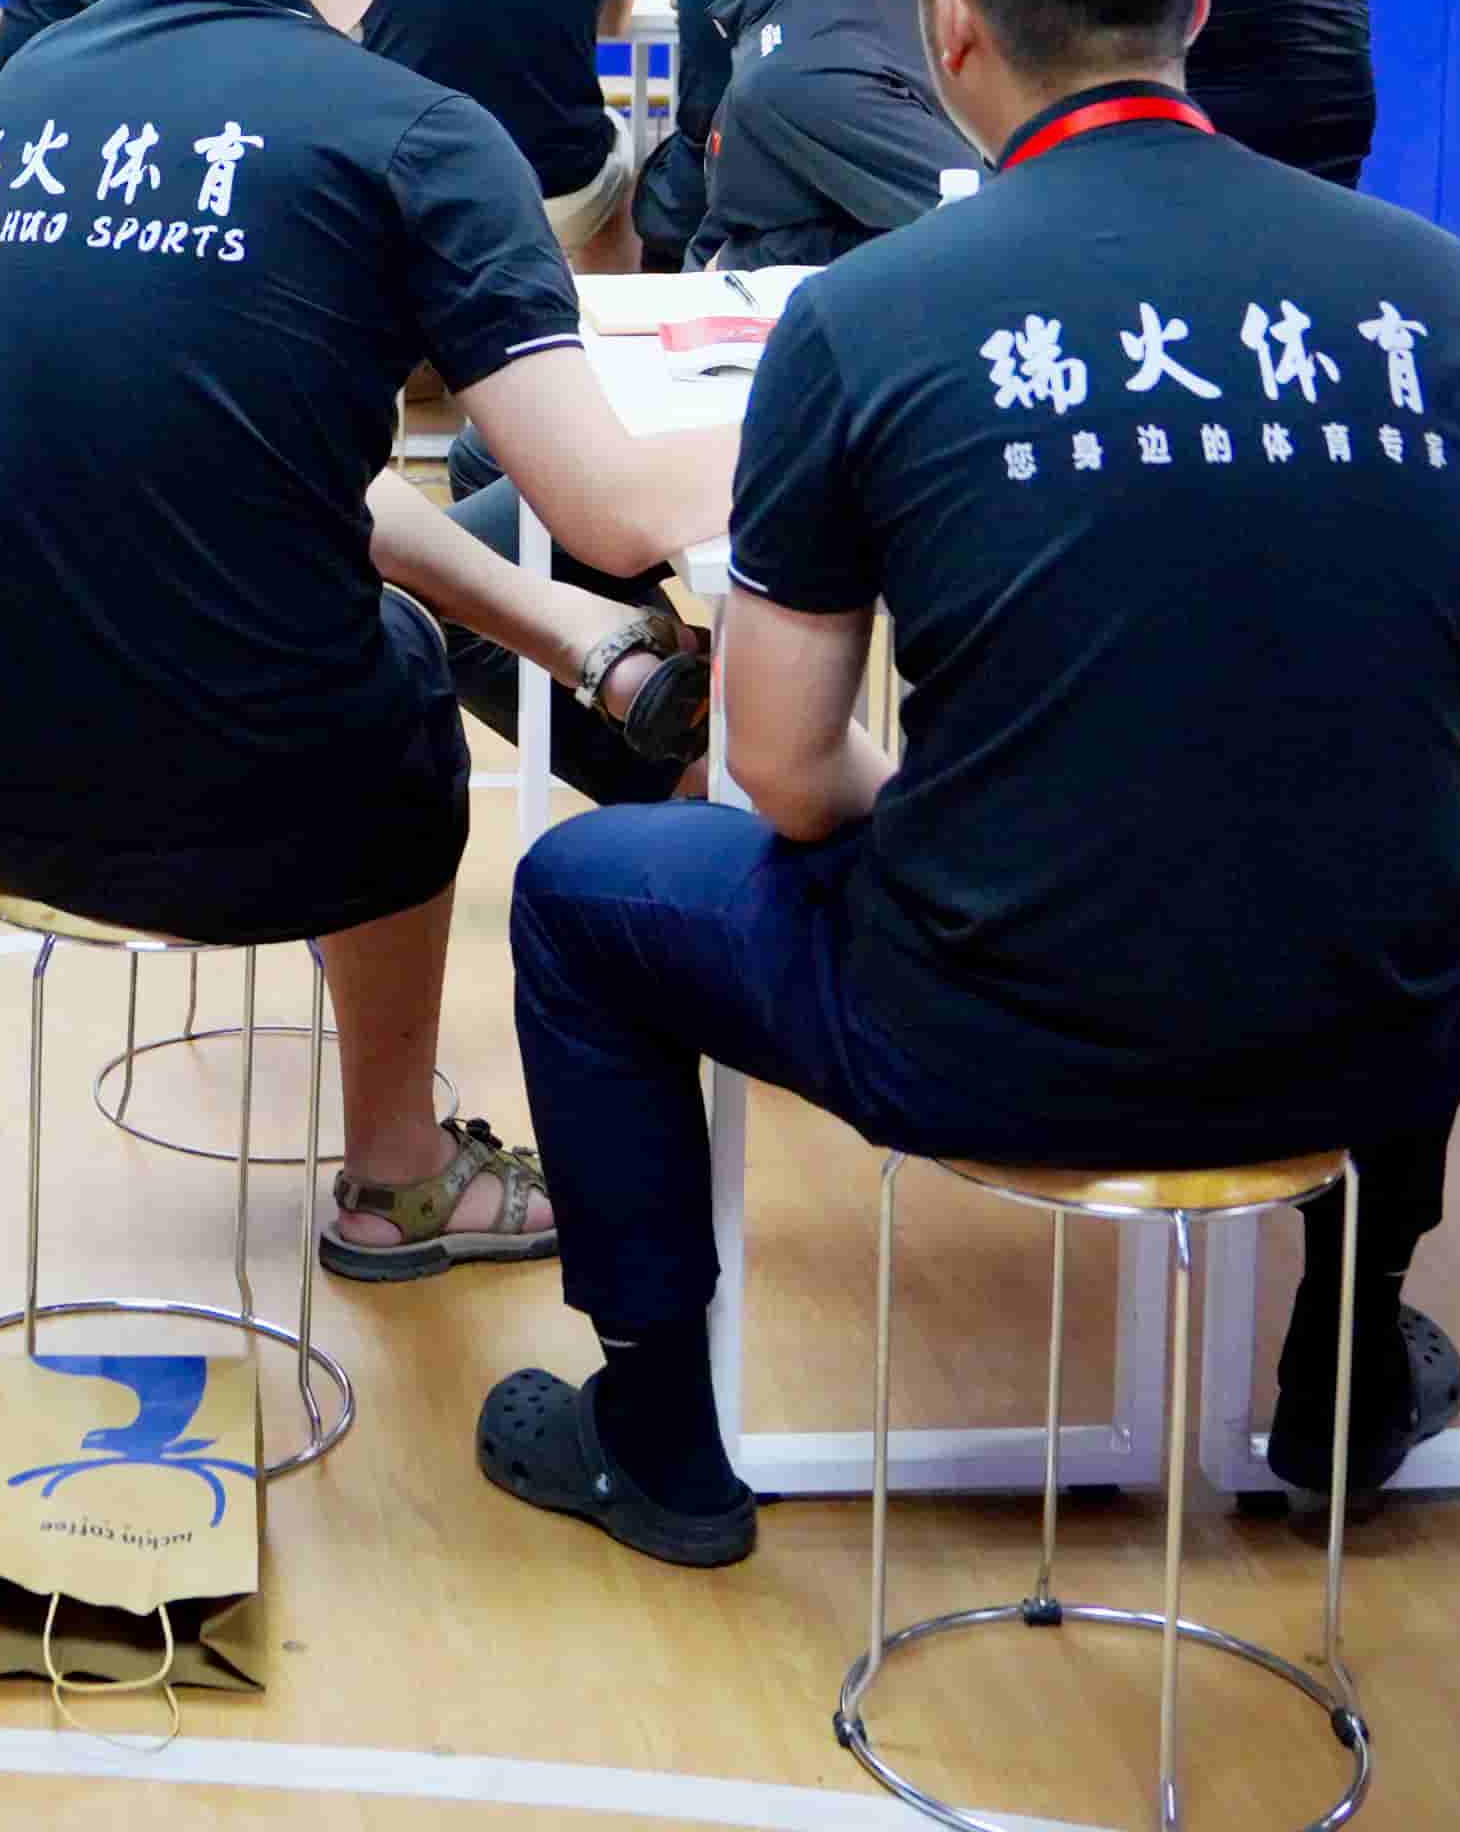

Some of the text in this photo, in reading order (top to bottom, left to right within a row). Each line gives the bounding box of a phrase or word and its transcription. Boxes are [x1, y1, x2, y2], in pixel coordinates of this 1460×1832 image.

[0, 210, 68, 243] HUO
[86, 215, 247, 263] SPORTS
[980, 299, 1429, 415] 瑞火体育
